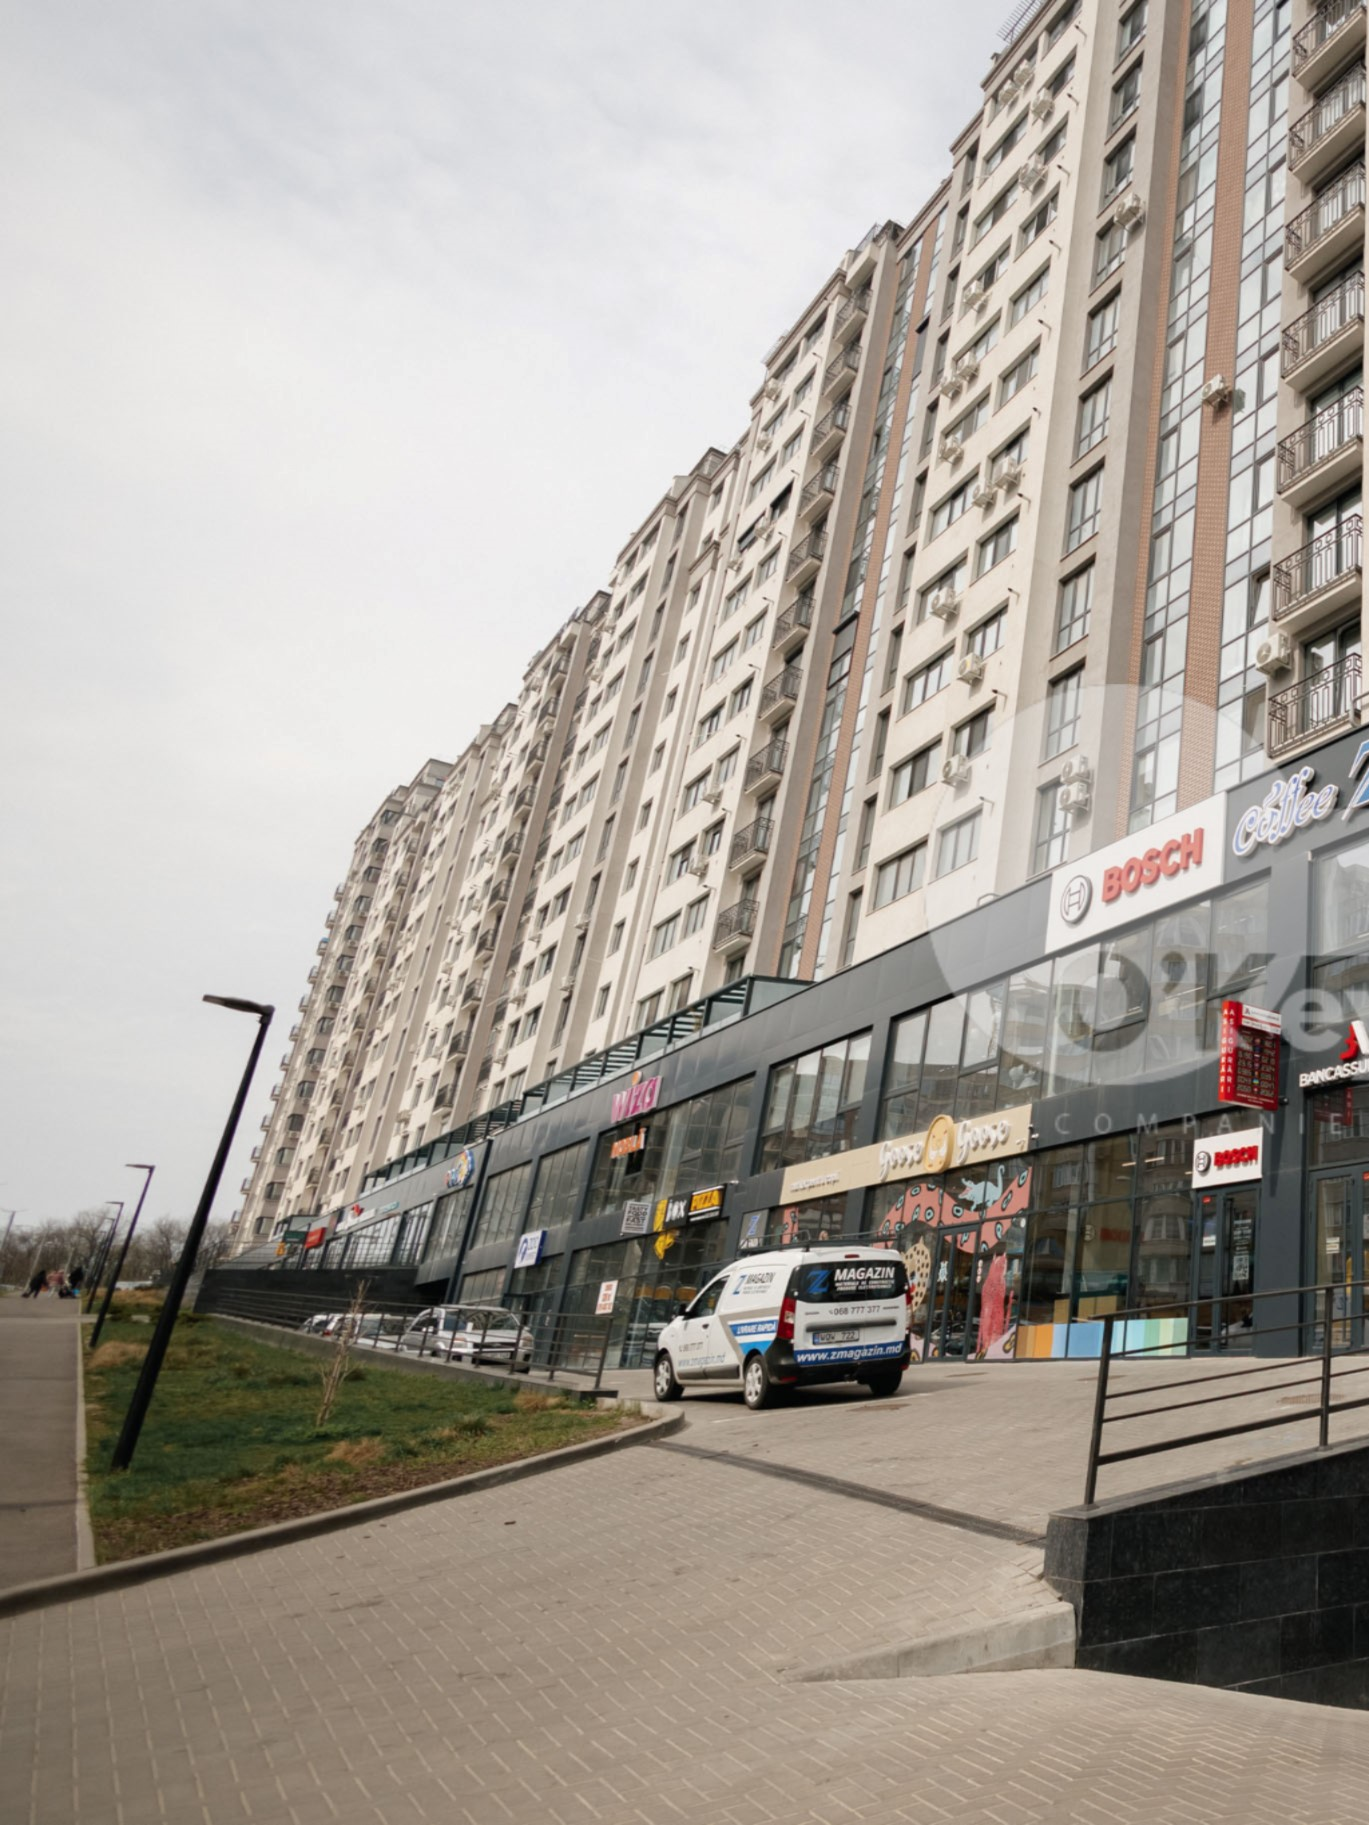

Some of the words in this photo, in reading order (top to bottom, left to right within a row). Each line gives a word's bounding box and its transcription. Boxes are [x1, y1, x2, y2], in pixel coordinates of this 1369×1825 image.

[1232, 766, 1339, 857] Coffee
[1101, 827, 1205, 903] BOSCH
[1214, 1145, 1259, 1167] BOSCH
[834, 1267, 896, 1282] MAGAZIN
[851, 1306, 865, 1314] 777
[867, 1305, 881, 1314] 377
[841, 1332, 856, 1340] 722
[797, 1343, 902, 1363] www.zmagazin.md
